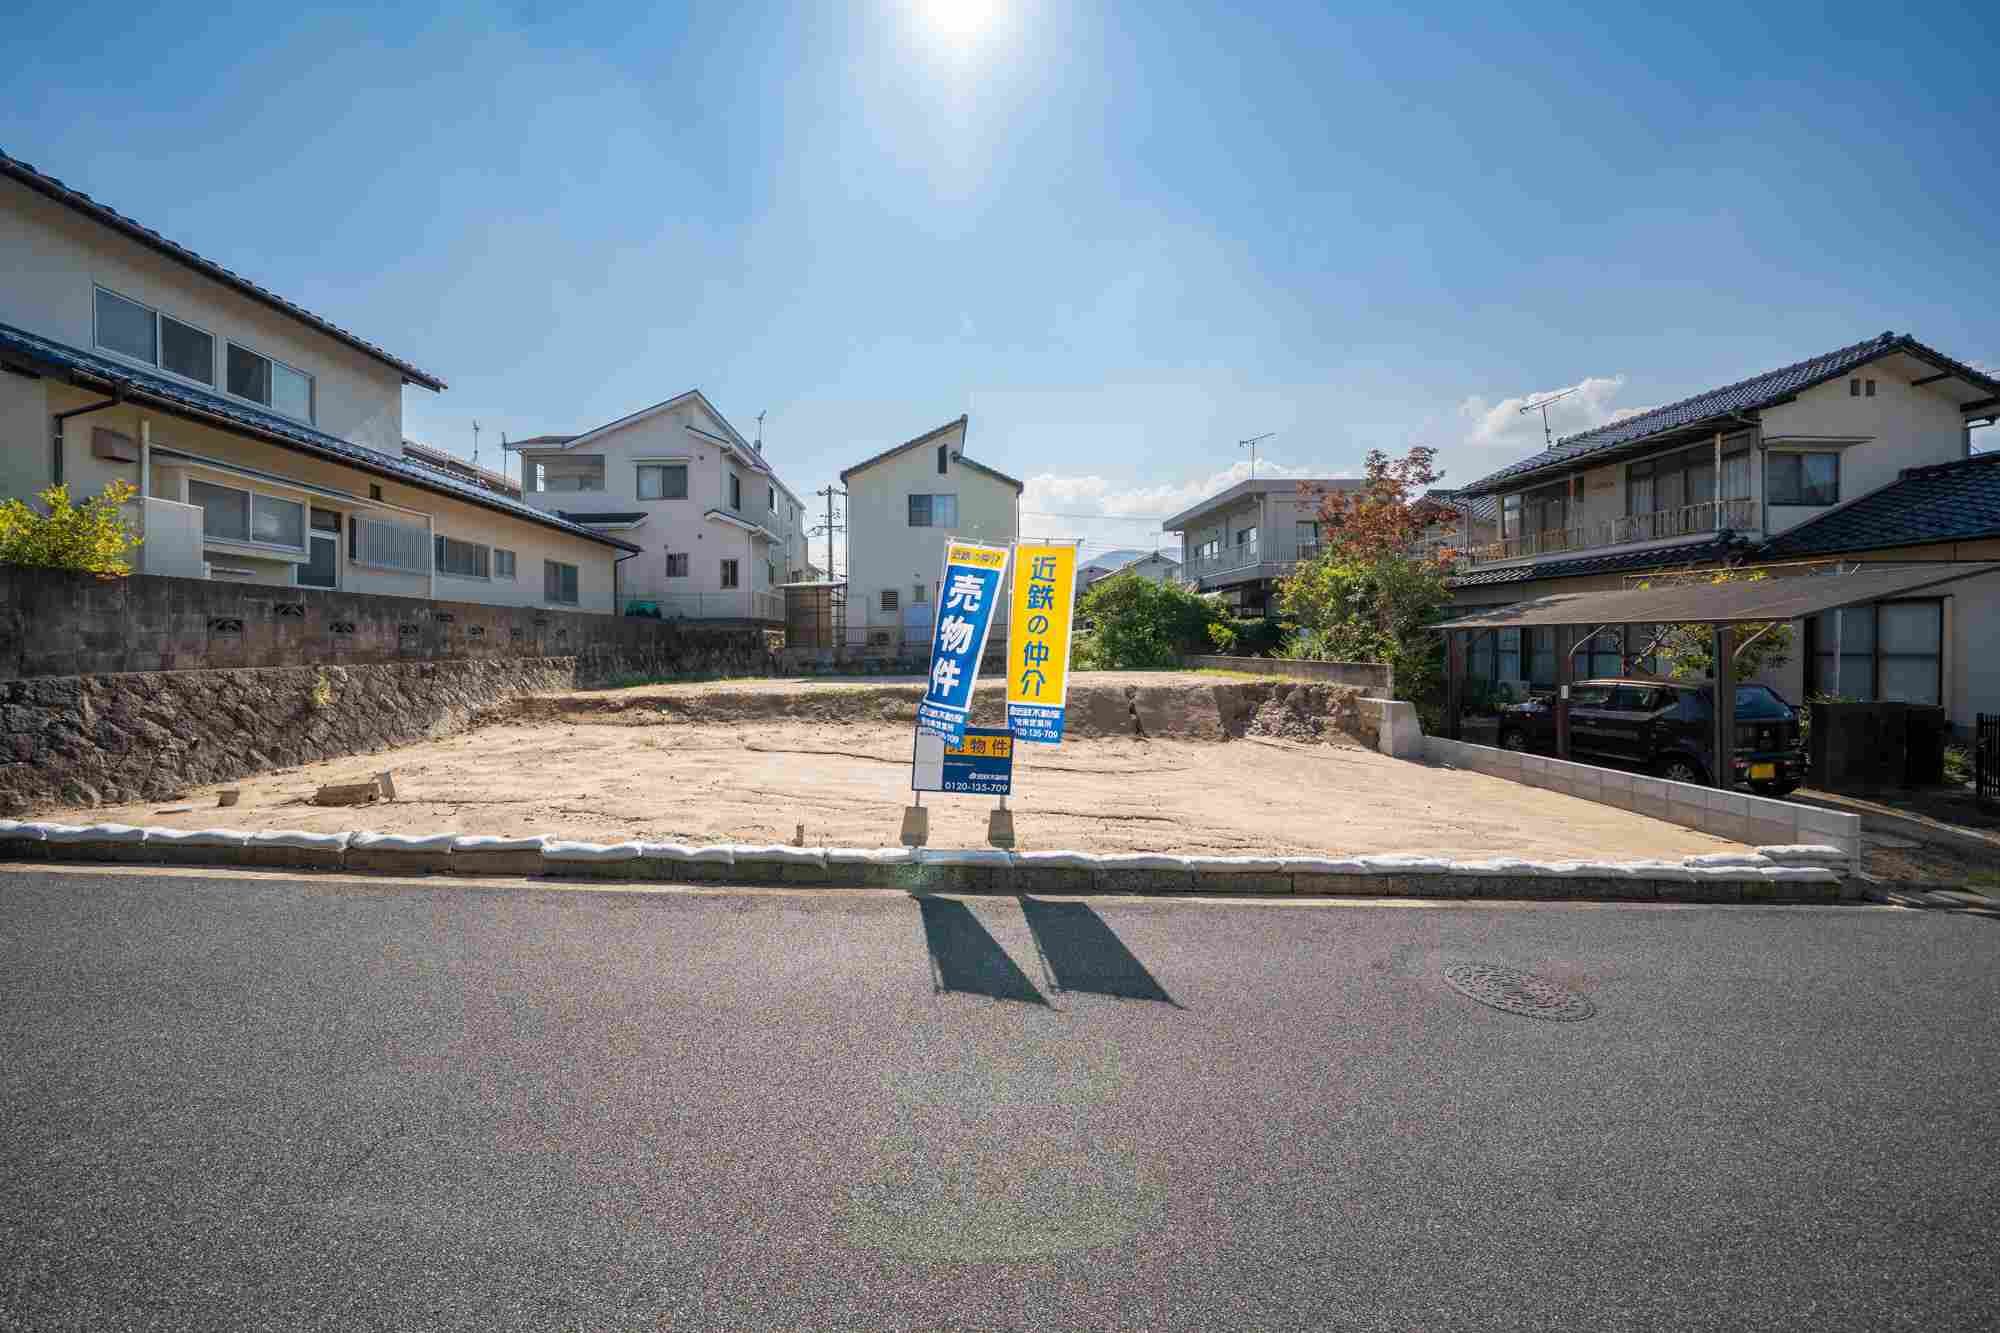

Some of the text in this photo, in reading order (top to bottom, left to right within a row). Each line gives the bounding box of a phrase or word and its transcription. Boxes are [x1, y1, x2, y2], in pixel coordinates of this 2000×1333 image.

[932, 574, 985, 697] 売物件
[1020, 556, 1056, 697] 近鉄の仲介
[944, 782, 1009, 793] 0120-135-709
